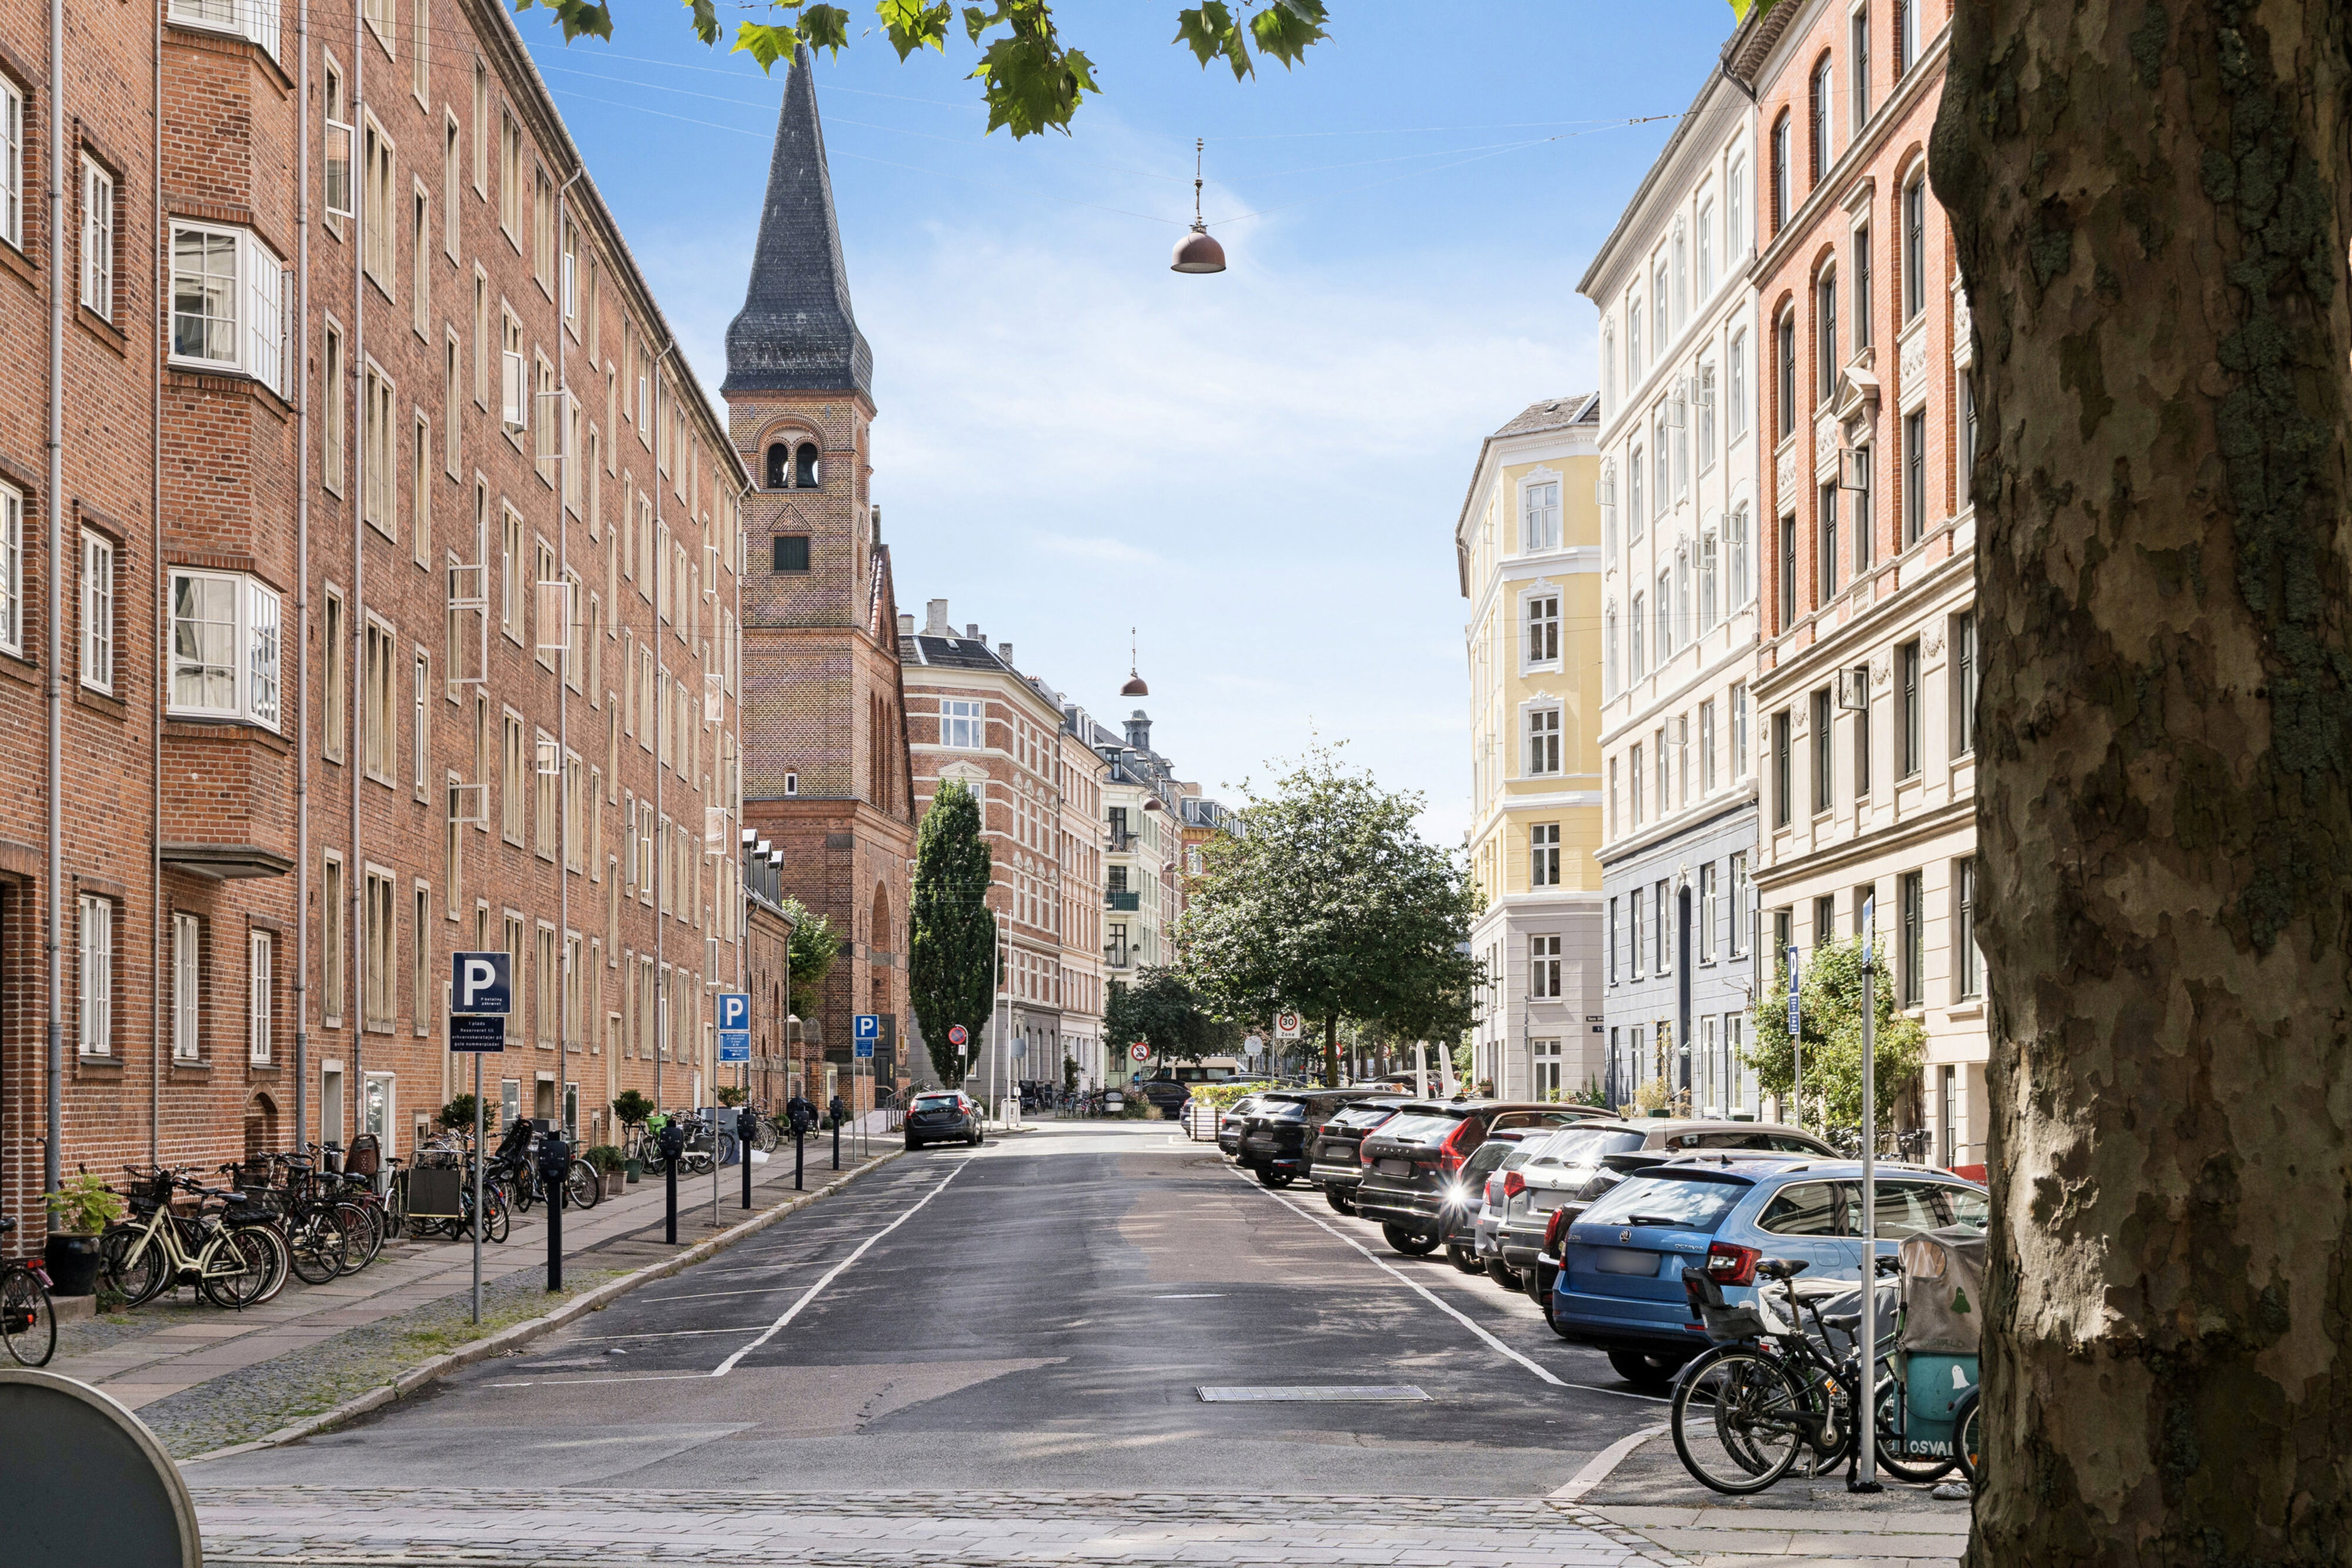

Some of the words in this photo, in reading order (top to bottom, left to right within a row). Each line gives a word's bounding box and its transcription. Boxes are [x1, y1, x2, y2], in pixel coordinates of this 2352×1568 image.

[464, 959, 496, 1006] P
[1790, 951, 1796, 988] P
[727, 998, 743, 1026] P
[861, 1018, 874, 1036] P
[1910, 1440, 1969, 1456] OSVAL
